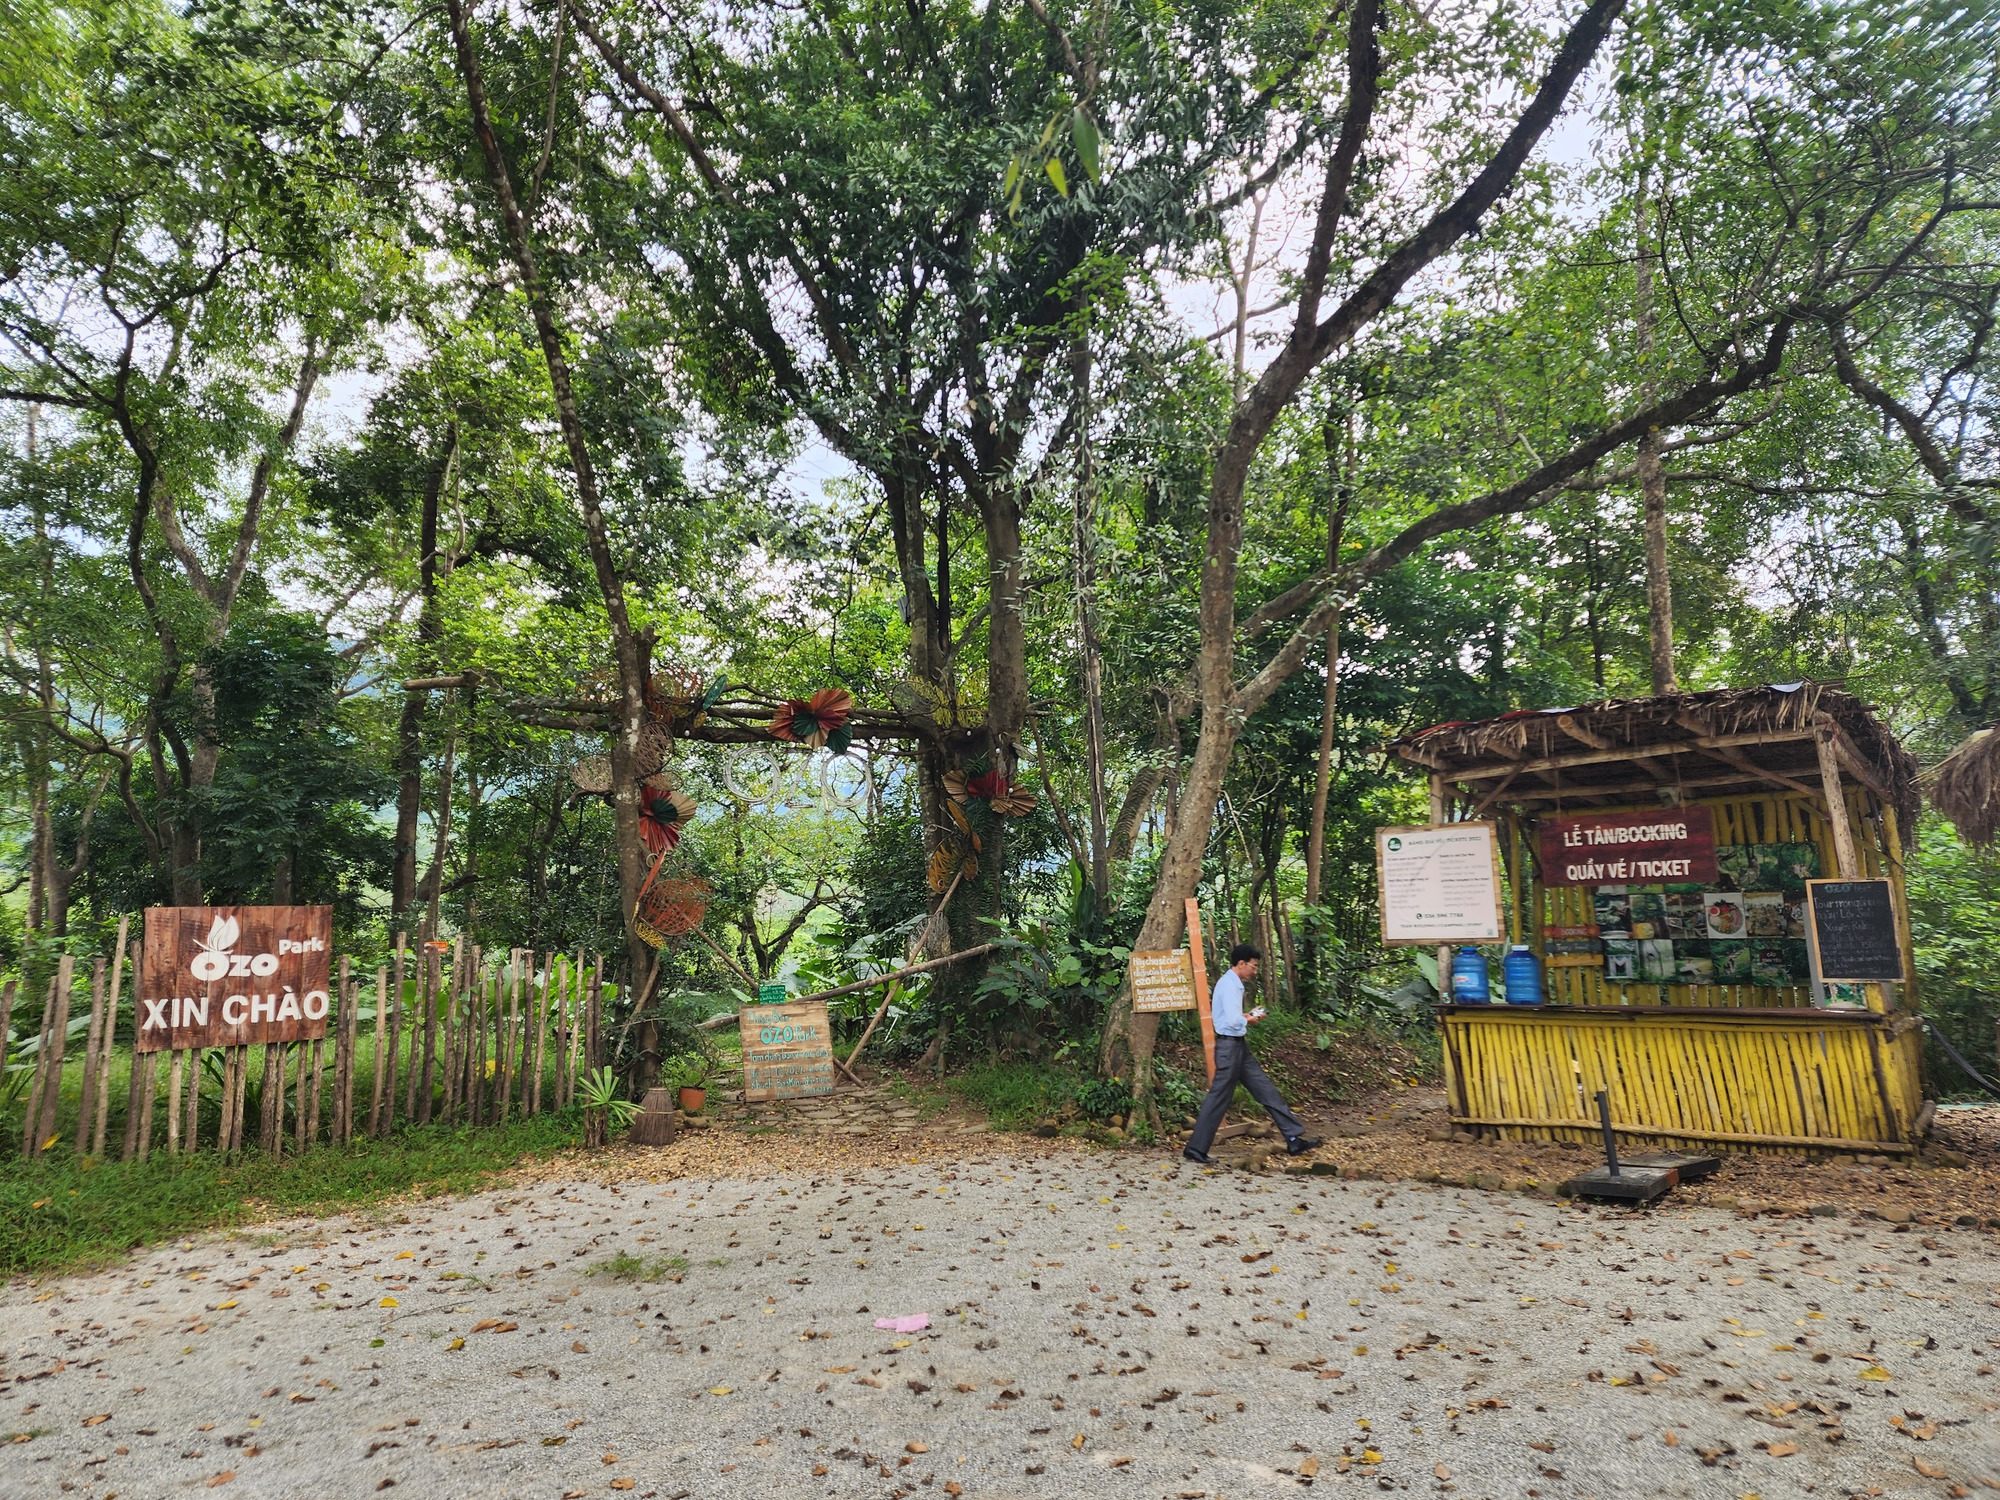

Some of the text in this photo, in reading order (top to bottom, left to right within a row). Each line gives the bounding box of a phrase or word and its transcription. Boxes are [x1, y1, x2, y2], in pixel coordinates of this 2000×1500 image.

[1585, 823, 1687, 845] TÂN/BOOKING
[1607, 858, 1627, 879] VÉ
[1637, 860, 1691, 877] TICKET
[278, 937, 324, 956] Park
[141, 986, 330, 1031] XIN CHÀO
[760, 1024, 818, 1045] OZO Park
